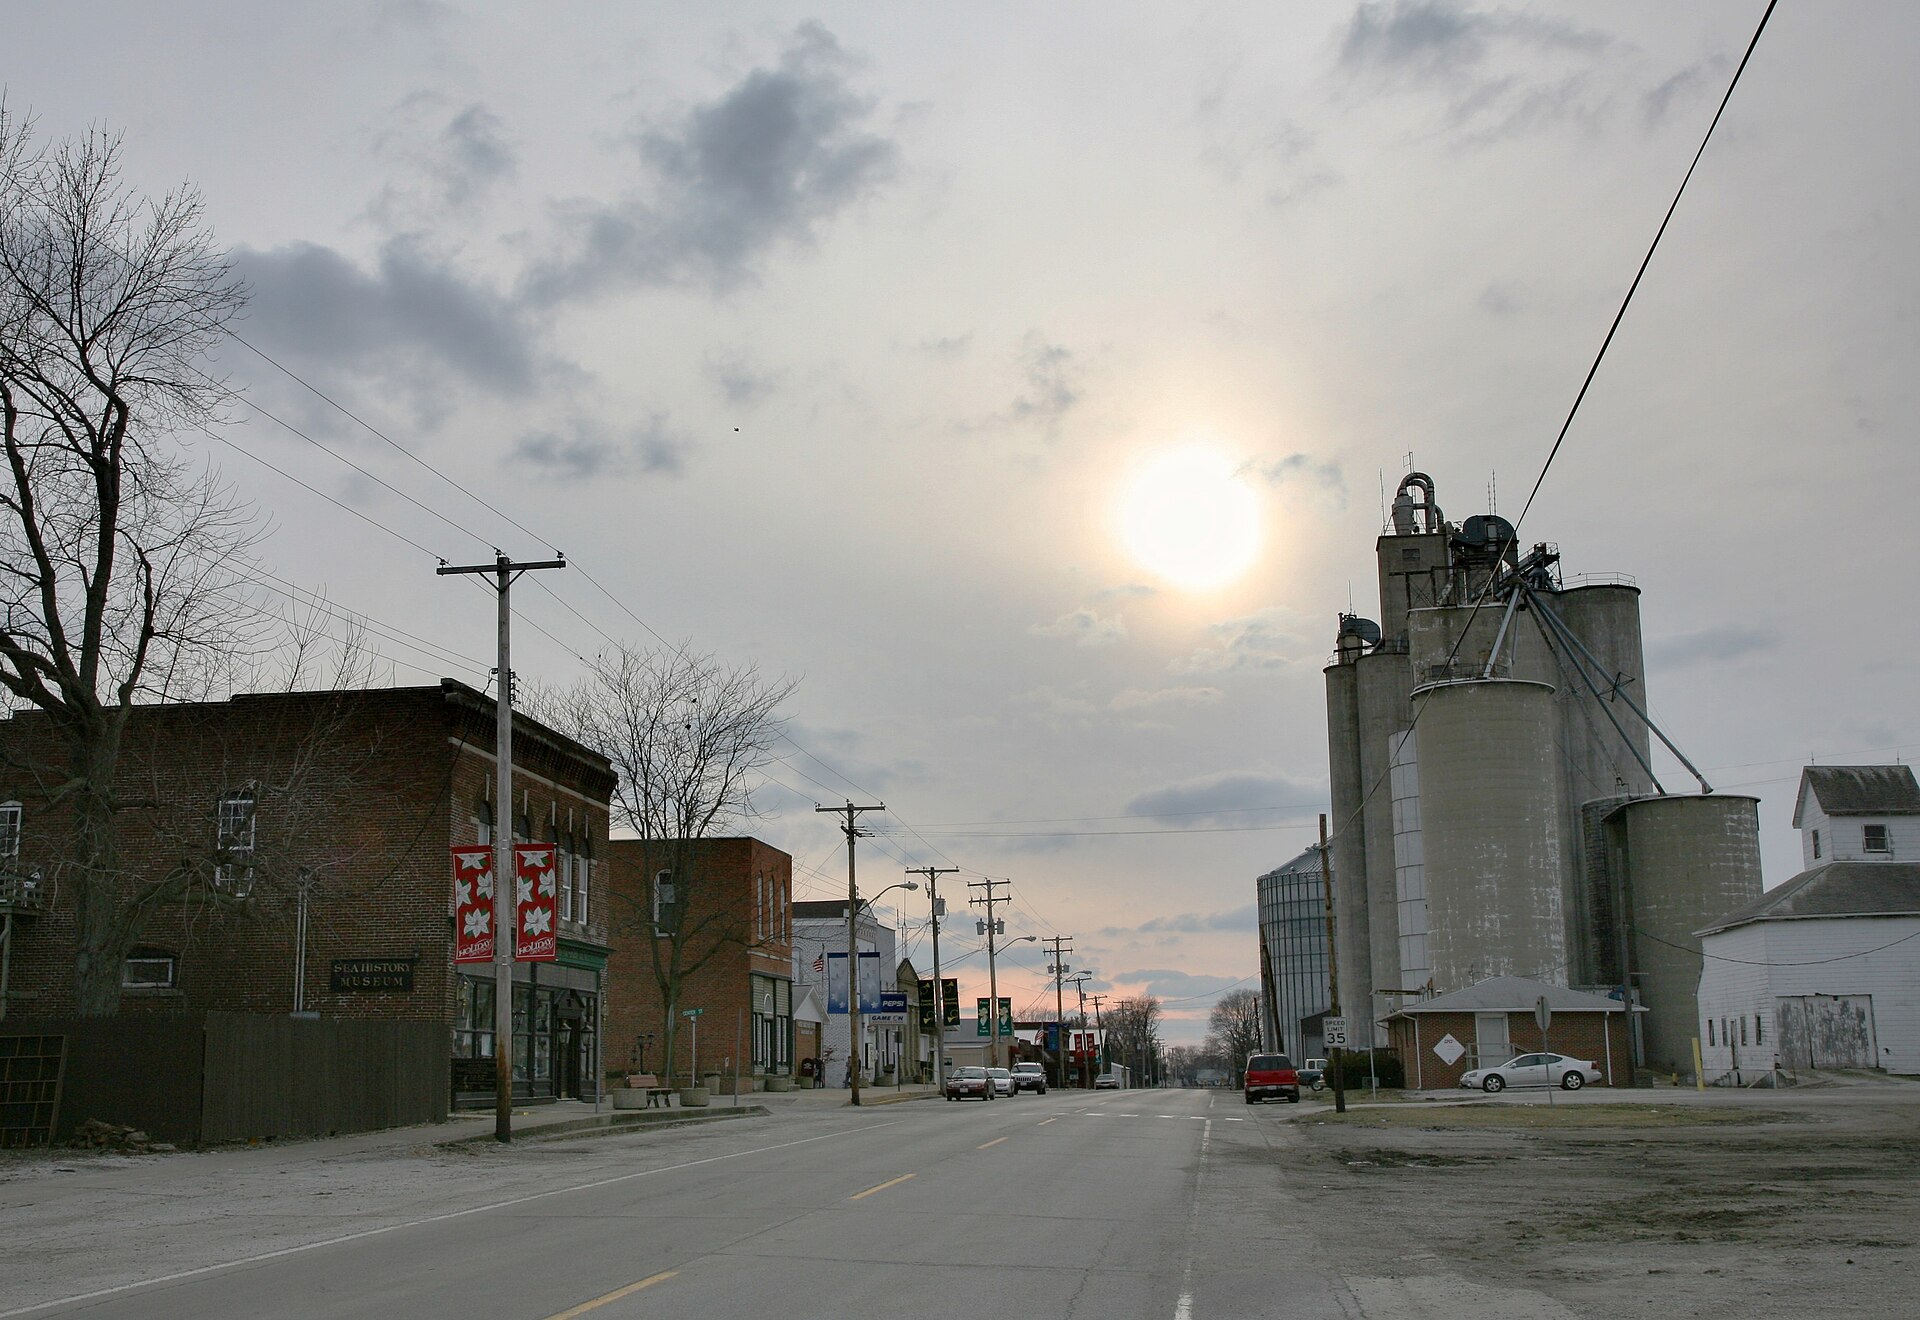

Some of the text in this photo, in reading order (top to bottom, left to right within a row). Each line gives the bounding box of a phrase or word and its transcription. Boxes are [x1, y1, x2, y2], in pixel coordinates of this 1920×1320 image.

[458, 938, 492, 957] HOLIDAY
[518, 937, 553, 955] HOLIDAY
[360, 963, 410, 972] HISTORY
[340, 976, 403, 987] MUSEUM
[1327, 1033, 1346, 1044] 35
